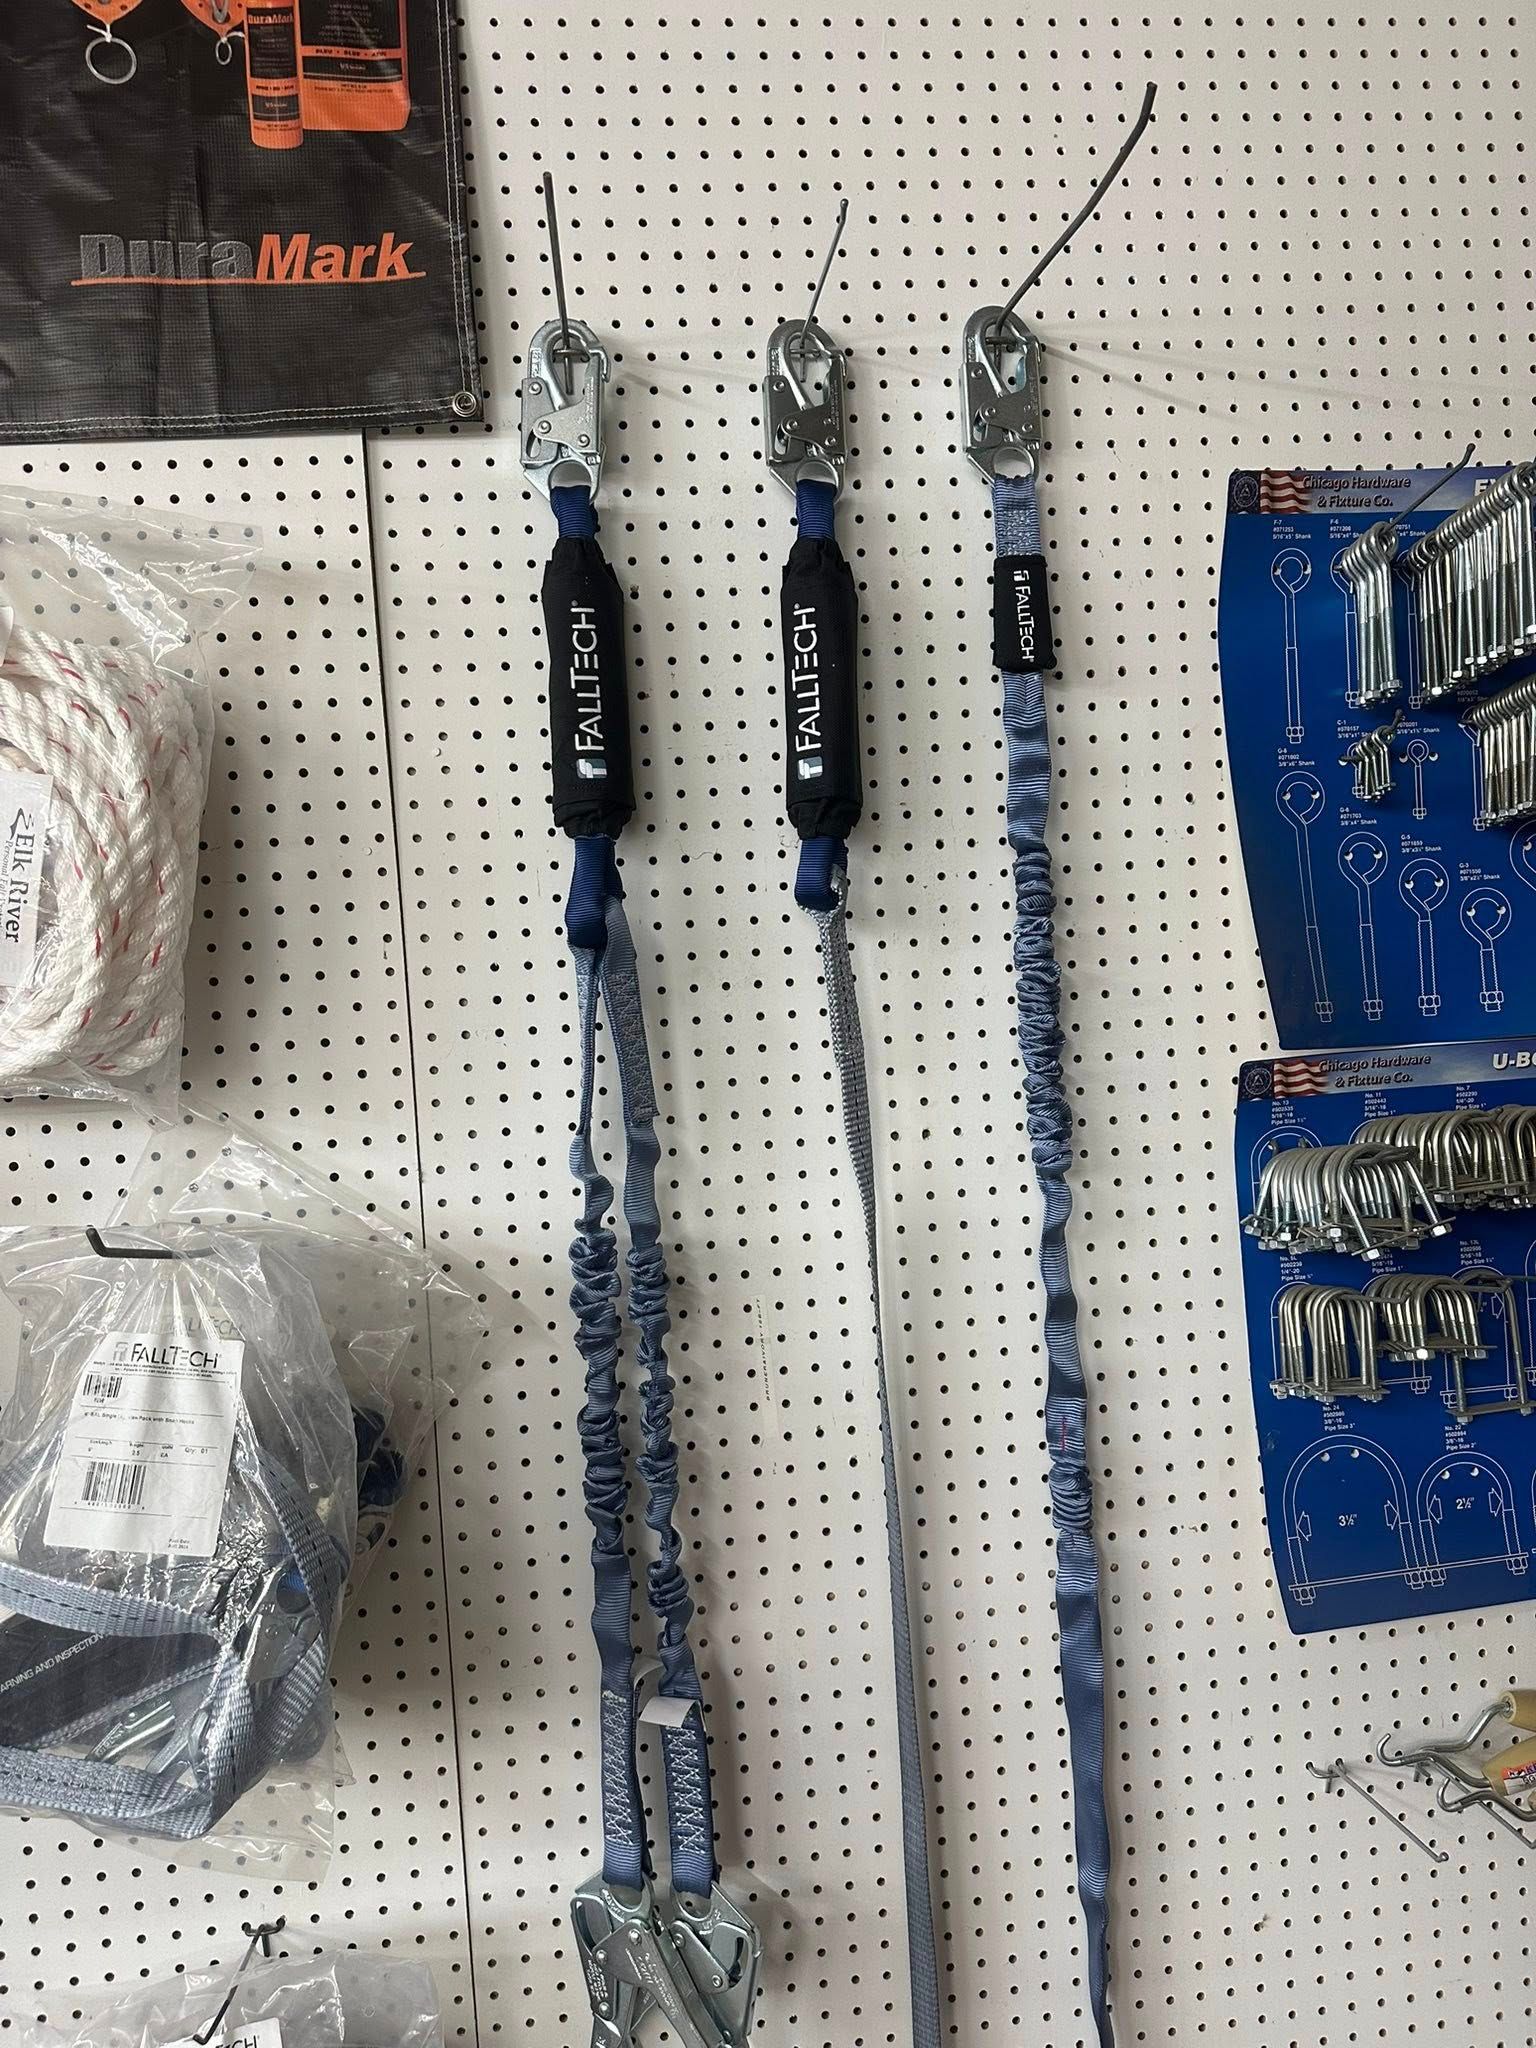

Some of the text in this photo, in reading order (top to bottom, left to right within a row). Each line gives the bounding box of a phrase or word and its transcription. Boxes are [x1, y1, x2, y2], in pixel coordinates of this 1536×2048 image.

[79, 232, 414, 281] DuraMark
[1303, 475, 1349, 492] Chicago
[1351, 475, 1412, 489] Hardware
[1316, 494, 1394, 508] & Fixture Co.
[1014, 585, 1035, 660] FALLTECH
[570, 607, 605, 751] FALLTECH
[791, 607, 822, 752] FALLTECH
[6, 834, 35, 943] Elk River
[1318, 1058, 1368, 1074] Chicago
[1371, 1054, 1432, 1070] Hardware
[1334, 1072, 1414, 1088] & Fixture Co.
[130, 1343, 218, 1368] FALLTECH
[0, 1669, 34, 1694] ARNING
[35, 1658, 55, 1675] AND
